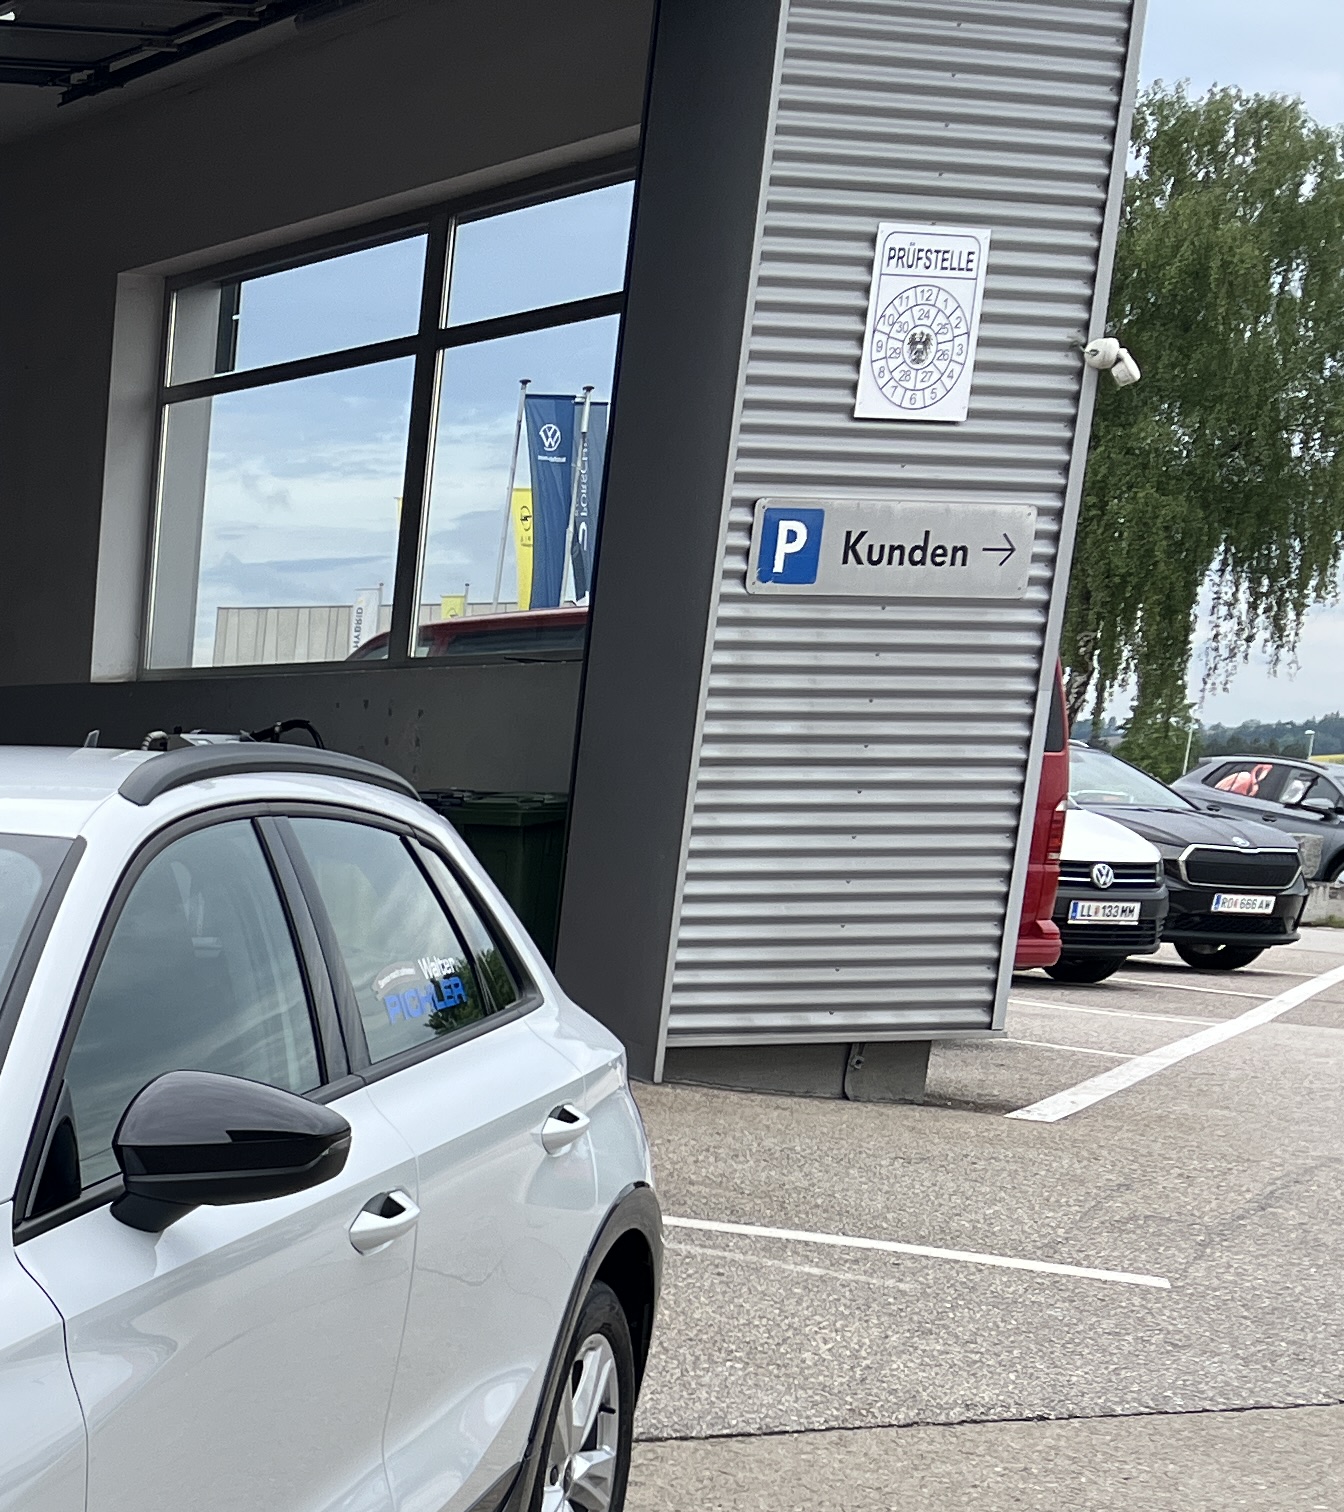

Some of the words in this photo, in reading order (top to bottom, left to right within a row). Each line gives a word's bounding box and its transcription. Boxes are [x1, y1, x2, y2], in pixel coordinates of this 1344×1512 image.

[886, 242, 976, 272] PRÜFSTELLE
[898, 294, 910, 308] 11
[919, 289, 934, 302] 12
[943, 298, 949, 310] 1
[882, 314, 894, 326] 10
[917, 309, 931, 321] 24
[896, 321, 909, 333] 30
[936, 322, 950, 335] 25
[954, 316, 962, 329] 2
[875, 340, 884, 352] 9
[888, 346, 901, 359] 29
[956, 343, 964, 356] 3
[936, 349, 950, 361] 26
[877, 366, 885, 378] 8
[899, 369, 912, 382] 28
[920, 370, 934, 383] 27
[946, 367, 954, 379] 4
[890, 386, 899, 398] 7
[930, 387, 938, 400] 5
[909, 393, 917, 406] 6
[772, 519, 808, 574] P
[841, 530, 969, 567] Kunden
[417, 955, 458, 981] Walter
[383, 976, 467, 1024] PICHLER
